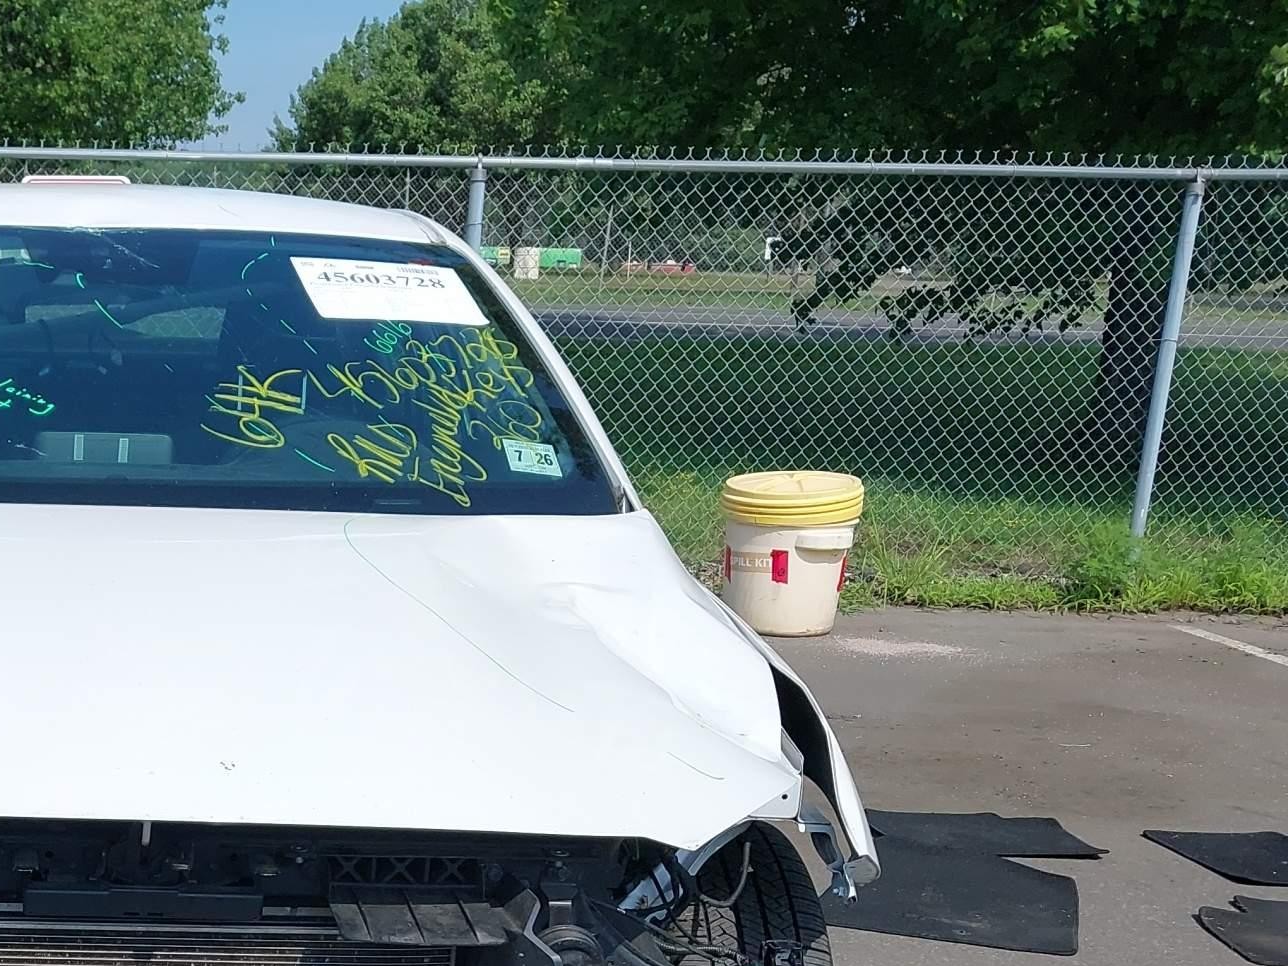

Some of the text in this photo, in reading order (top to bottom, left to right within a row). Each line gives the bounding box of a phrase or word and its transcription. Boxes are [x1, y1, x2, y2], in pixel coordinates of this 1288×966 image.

[317, 271, 446, 289] 45603728
[363, 319, 412, 354] 6616
[514, 449, 554, 466] 7 26
[733, 556, 753, 566] PILL
